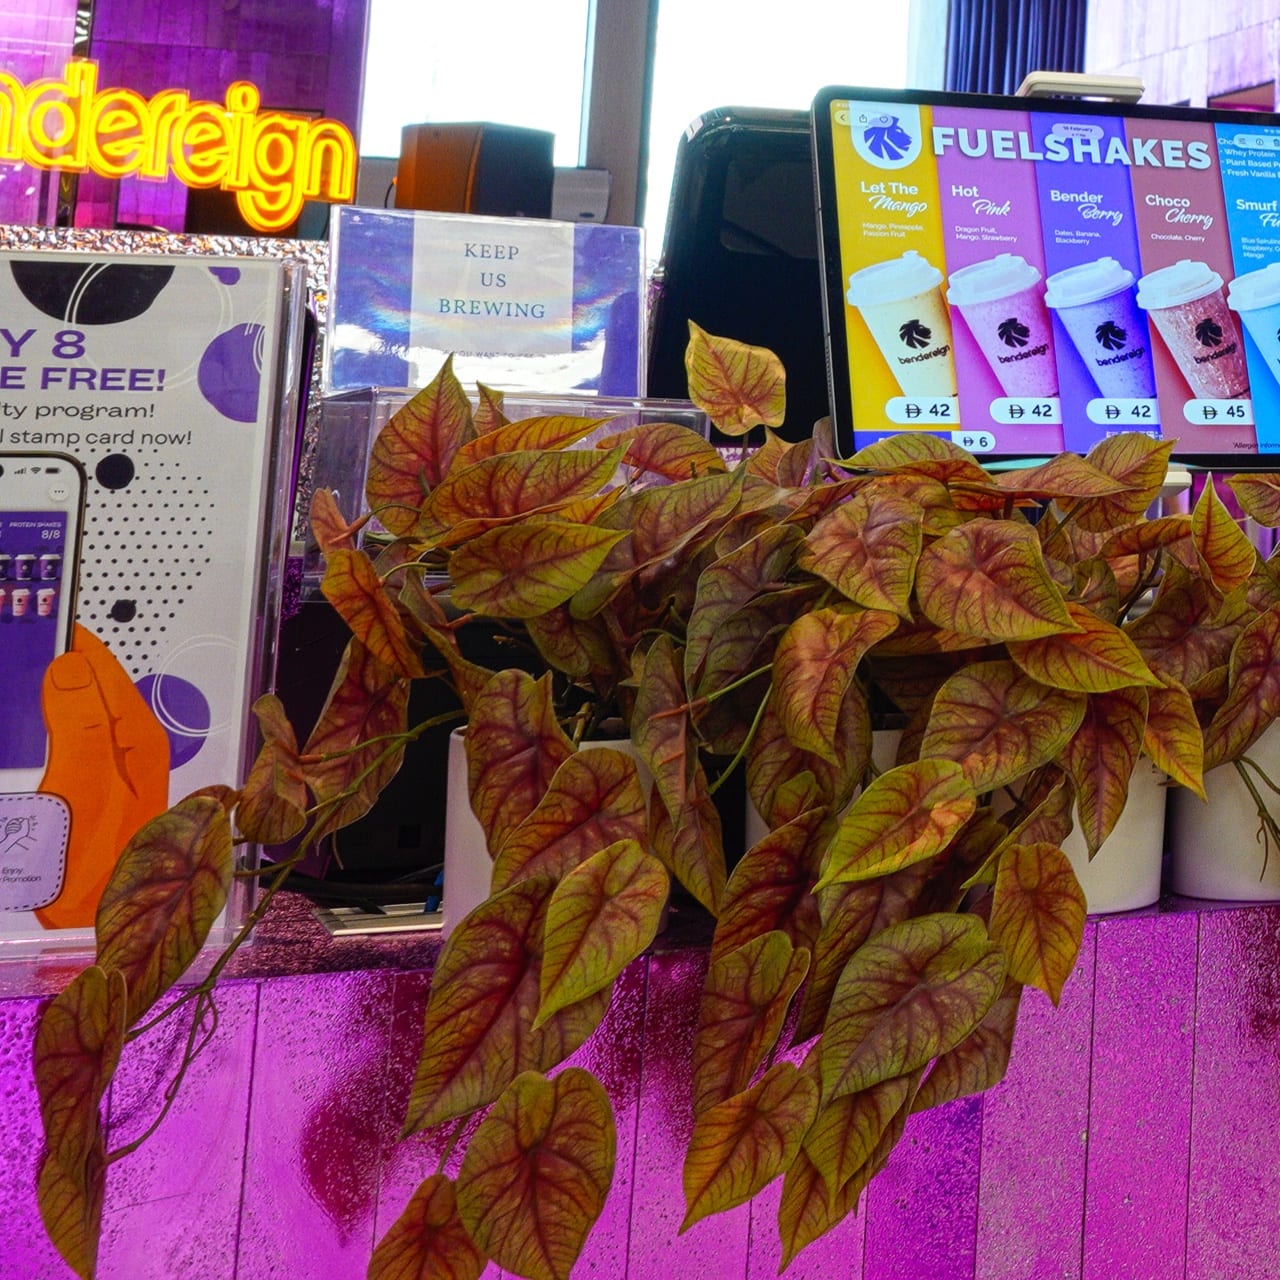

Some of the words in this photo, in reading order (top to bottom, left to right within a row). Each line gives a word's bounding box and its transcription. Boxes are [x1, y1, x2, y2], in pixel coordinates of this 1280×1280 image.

[932, 126, 1212, 169] FUELSHAKES
[1224, 149, 1247, 158] Whey
[1248, 150, 1276, 158] Protein
[1226, 159, 1246, 167] Plant
[1248, 160, 1272, 168] Based
[1227, 169, 1249, 177] Fresh
[1250, 170, 1276, 178] Vanilla
[860, 181, 886, 193] Let
[888, 182, 918, 195] The
[952, 185, 979, 197] Hot
[1050, 190, 1103, 203] Bender
[1145, 194, 1190, 207] Choco
[868, 195, 928, 218] Mango
[972, 199, 1010, 216] Pink
[1236, 199, 1278, 210] Smurf
[1077, 203, 1124, 226] Berry
[1165, 208, 1214, 230] Cherry
[955, 226, 980, 234] Dragon
[981, 235, 1017, 243] Strawberry
[1056, 237, 1090, 246] Blackberry
[1184, 234, 1205, 243] Cherry
[464, 243, 519, 260] KEEP
[480, 272, 506, 287] US
[438, 298, 546, 319] BREWING
[0, 329, 37, 357] Y
[52, 330, 86, 359] 8
[898, 344, 951, 365] bendereign
[997, 343, 1050, 365] bendereign
[1095, 346, 1146, 368] bendereign
[1193, 342, 1238, 365] bendereign
[0, 366, 27, 389] E
[40, 367, 166, 391] FREE!
[35, 404, 155, 421] program!
[929, 404, 951, 417] 42
[1032, 404, 1052, 417] 42
[1131, 405, 1151, 417] 42
[1226, 405, 1245, 417] 45
[10, 430, 80, 447] stamp
[85, 430, 134, 444] card
[141, 431, 192, 445] now!
[979, 436, 989, 448] 6
[41, 530, 60, 540] 8/8
